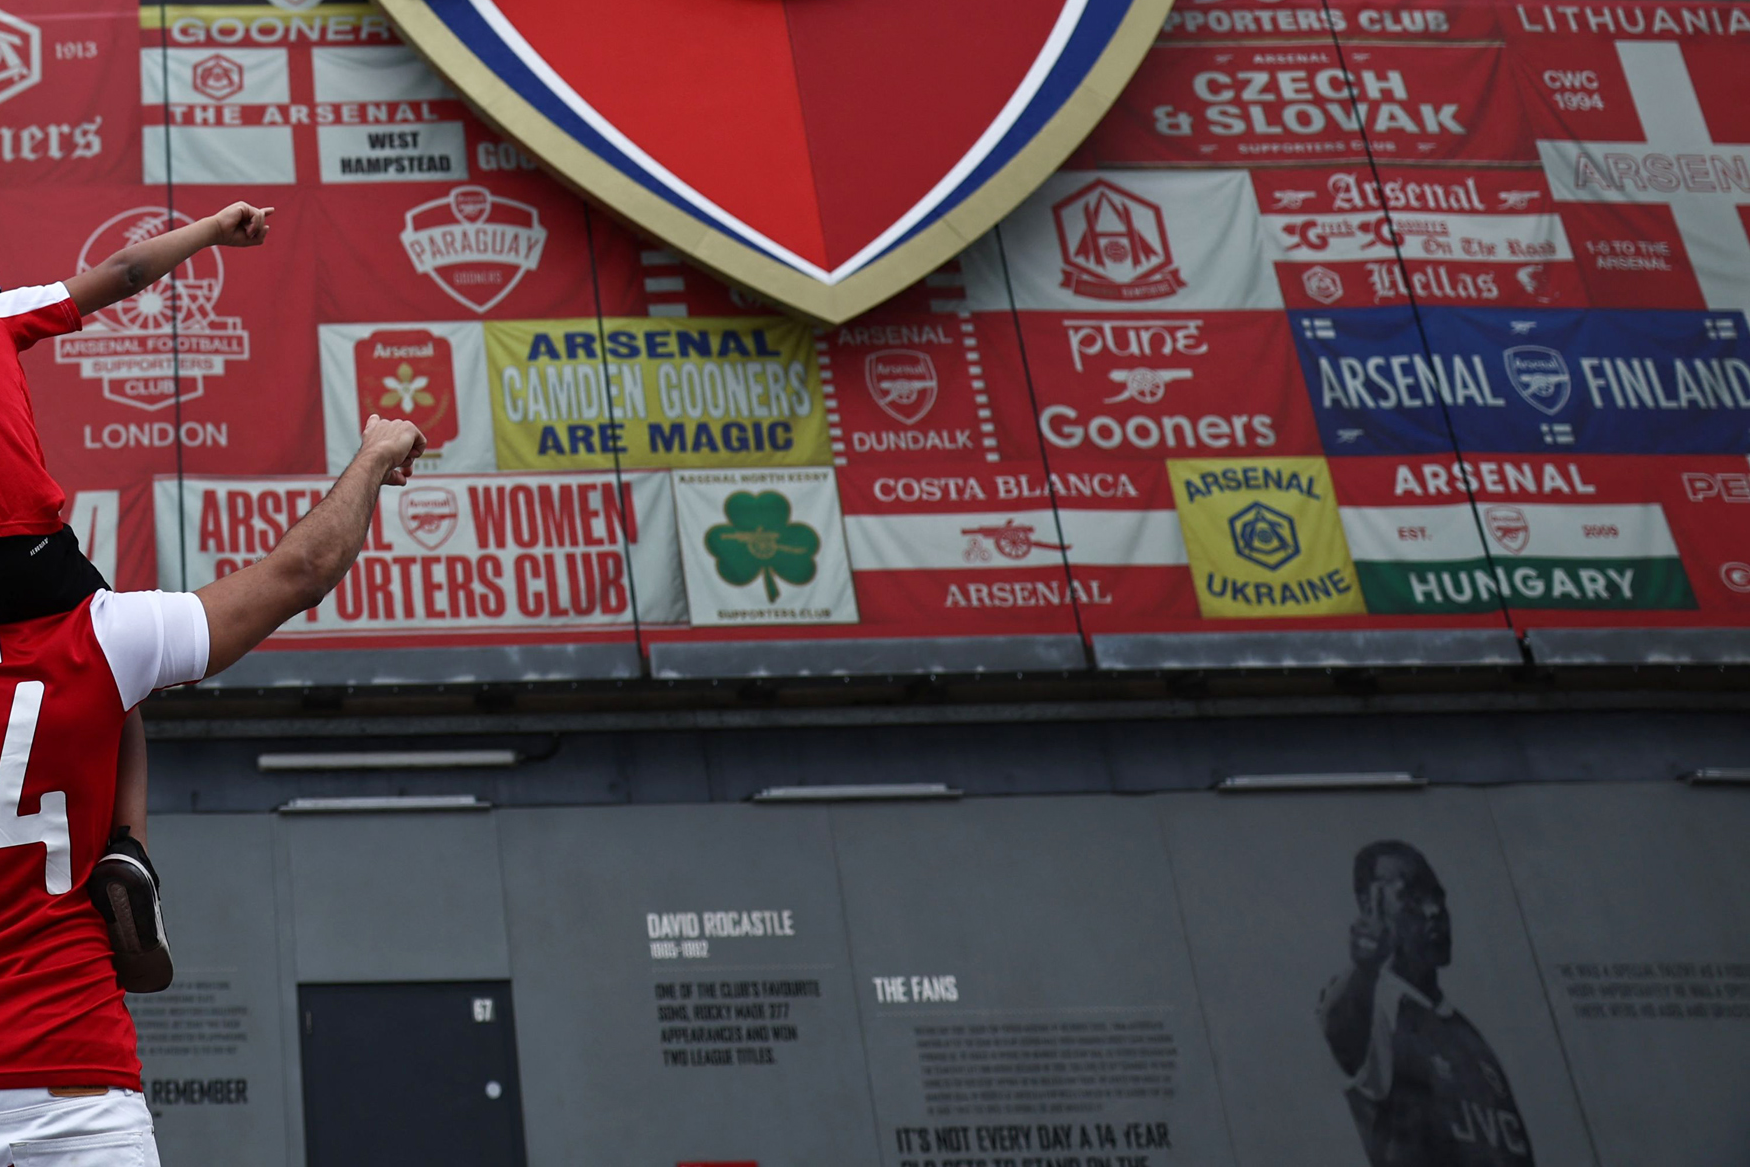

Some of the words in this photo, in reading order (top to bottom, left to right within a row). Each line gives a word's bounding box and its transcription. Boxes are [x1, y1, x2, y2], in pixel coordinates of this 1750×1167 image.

[1358, 10, 1449, 32] CLUB
[1517, 4, 1750, 35] LITHUANIA
[55, 42, 98, 60] 1913
[1192, 70, 1408, 102] CZECH
[174, 106, 244, 125] THE
[262, 102, 439, 125] ARSENAL
[1154, 106, 1192, 135] &
[1206, 103, 1466, 135] SLOVAK
[368, 132, 419, 150] WEST
[341, 155, 451, 174] HAMPSTEAD
[1328, 172, 1485, 212] Arsenal
[409, 226, 542, 268] PARAGUAY
[1366, 263, 1499, 302] Hellas
[62, 336, 142, 355] ARSENAL
[148, 336, 242, 353] FOOTBALL
[372, 342, 435, 360] Arsenal
[528, 330, 781, 360] ARSENAL
[124, 378, 176, 396] CLUB
[502, 363, 646, 422] CAMDEN
[658, 362, 812, 419] GOONERS
[1320, 356, 1505, 408] ARSENAL
[1581, 358, 1750, 409] FINLAND
[84, 423, 228, 449] LONDON
[538, 422, 624, 454] ARE
[648, 422, 794, 452] MAGIC
[854, 430, 972, 452] DUNDALK
[1039, 405, 1276, 448] Gooners
[874, 478, 986, 502] COSTA
[996, 474, 1138, 499] BLANCA
[1184, 469, 1321, 503] ARSENAL
[1395, 464, 1596, 495] ARSENAL
[468, 480, 638, 550] WOMEN
[514, 550, 629, 620] CLUB
[945, 580, 1111, 607] ARSENAL
[1206, 570, 1352, 608] UKRAINE
[1410, 568, 1634, 603] HUNGARY
[647, 913, 700, 938] DAVID
[703, 910, 795, 936] ROCASTLE
[656, 983, 677, 1000] ONE
[680, 983, 692, 999] OF
[700, 982, 717, 998] THE
[873, 977, 909, 1003] THE
[911, 976, 958, 1002] FANS
[472, 999, 494, 1022] 67
[663, 1050, 688, 1066] TWO
[691, 1048, 733, 1066] LEAGUE
[153, 1079, 248, 1105] REMEMBER
[896, 1128, 932, 1154] IT'S
[936, 1126, 970, 1153] NOT
[976, 1126, 1031, 1152] EVERY
[1037, 1125, 1074, 1150] DAY
[1080, 1125, 1094, 1150] A
[1099, 1123, 1117, 1150] 14
[1123, 1122, 1171, 1150] YEAR
[1452, 1099, 1526, 1155] JVC
